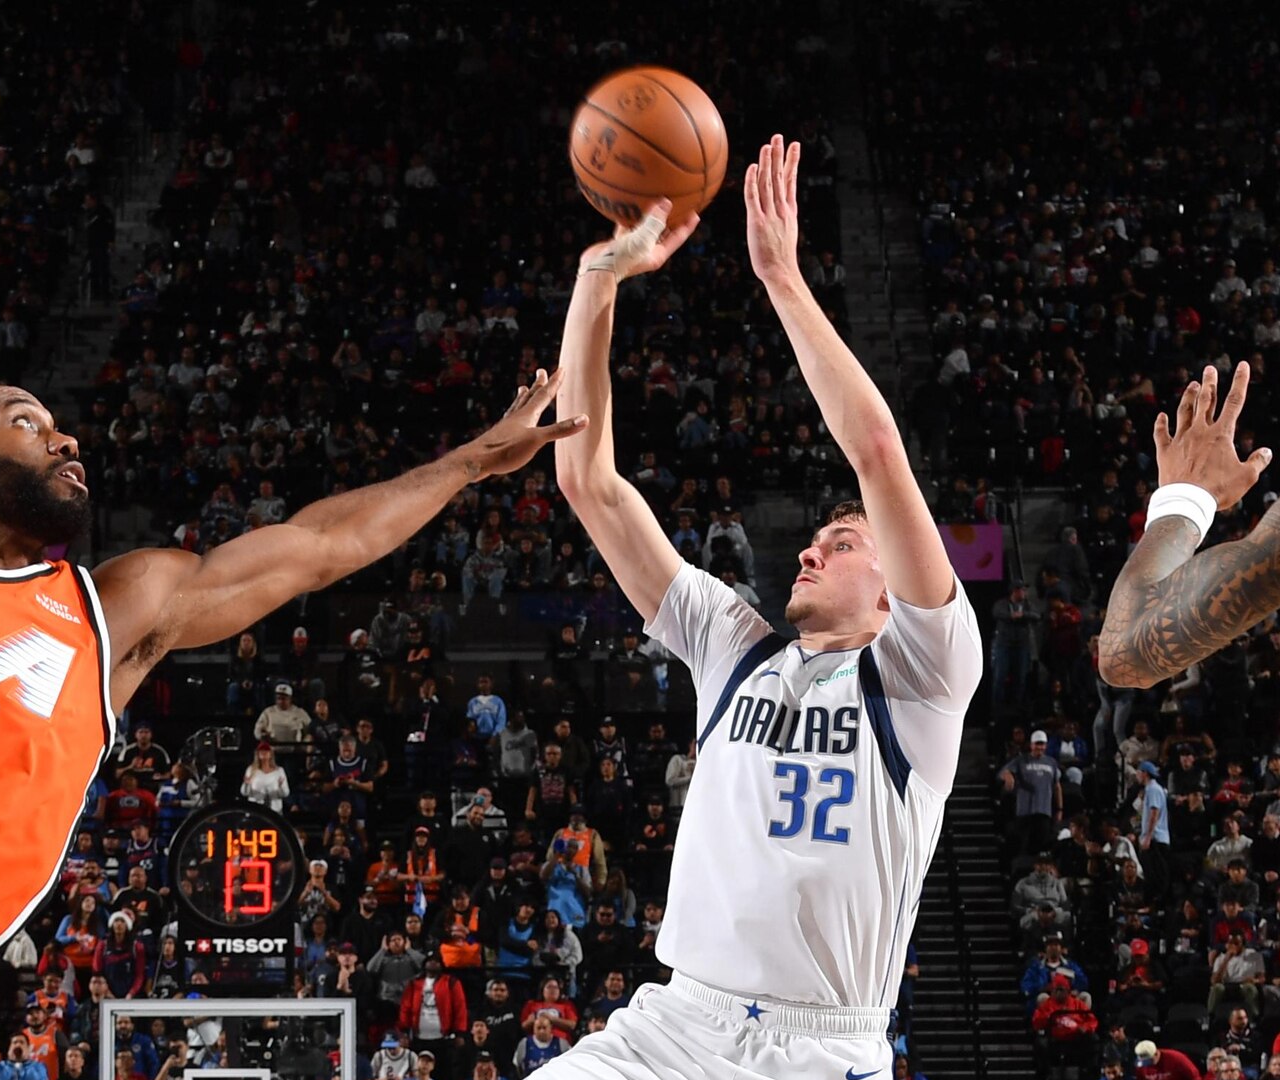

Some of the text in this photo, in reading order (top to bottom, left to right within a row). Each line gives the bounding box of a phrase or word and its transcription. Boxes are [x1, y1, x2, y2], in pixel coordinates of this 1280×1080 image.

[728, 695, 859, 756] DALLAS
[768, 761, 855, 846] 32
[206, 829, 278, 859] 11:49
[224, 860, 273, 914] 13
[213, 938, 288, 953] TISSOT
